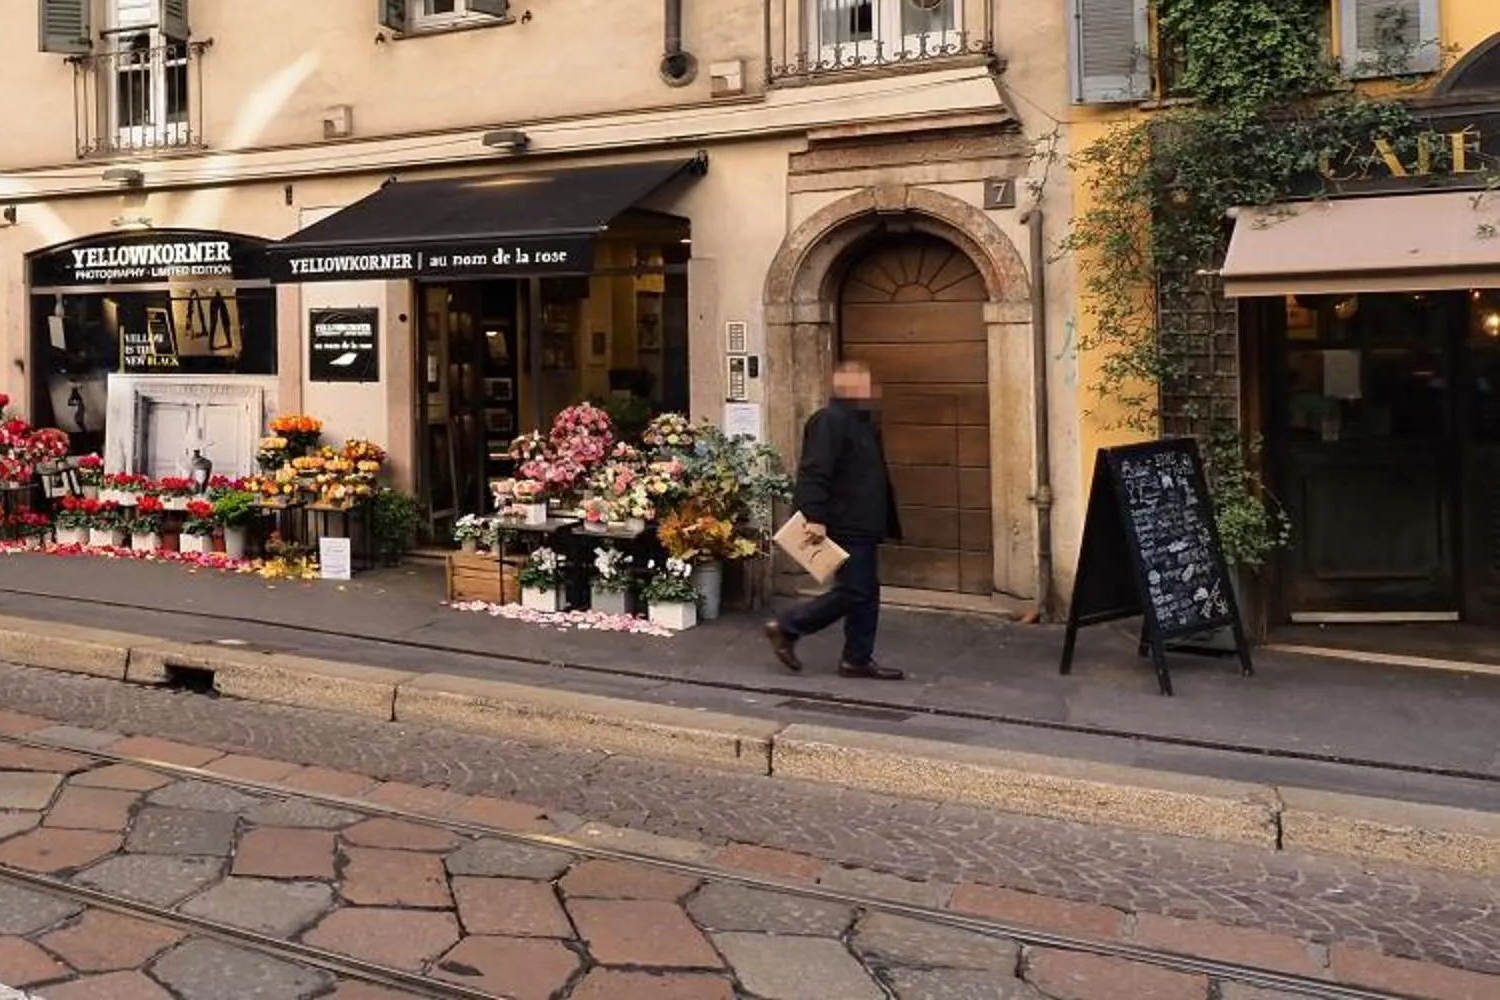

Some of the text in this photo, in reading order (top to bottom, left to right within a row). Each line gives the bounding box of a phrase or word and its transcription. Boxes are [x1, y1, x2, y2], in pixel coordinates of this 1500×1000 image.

[991, 182, 1007, 203] 7
[71, 241, 231, 268] YELLOWKORNER
[289, 248, 568, 274] YELLOWKORNER au nom de la rose
[75, 264, 232, 280] PHOTOGRAPHY LIMITED EDITION
